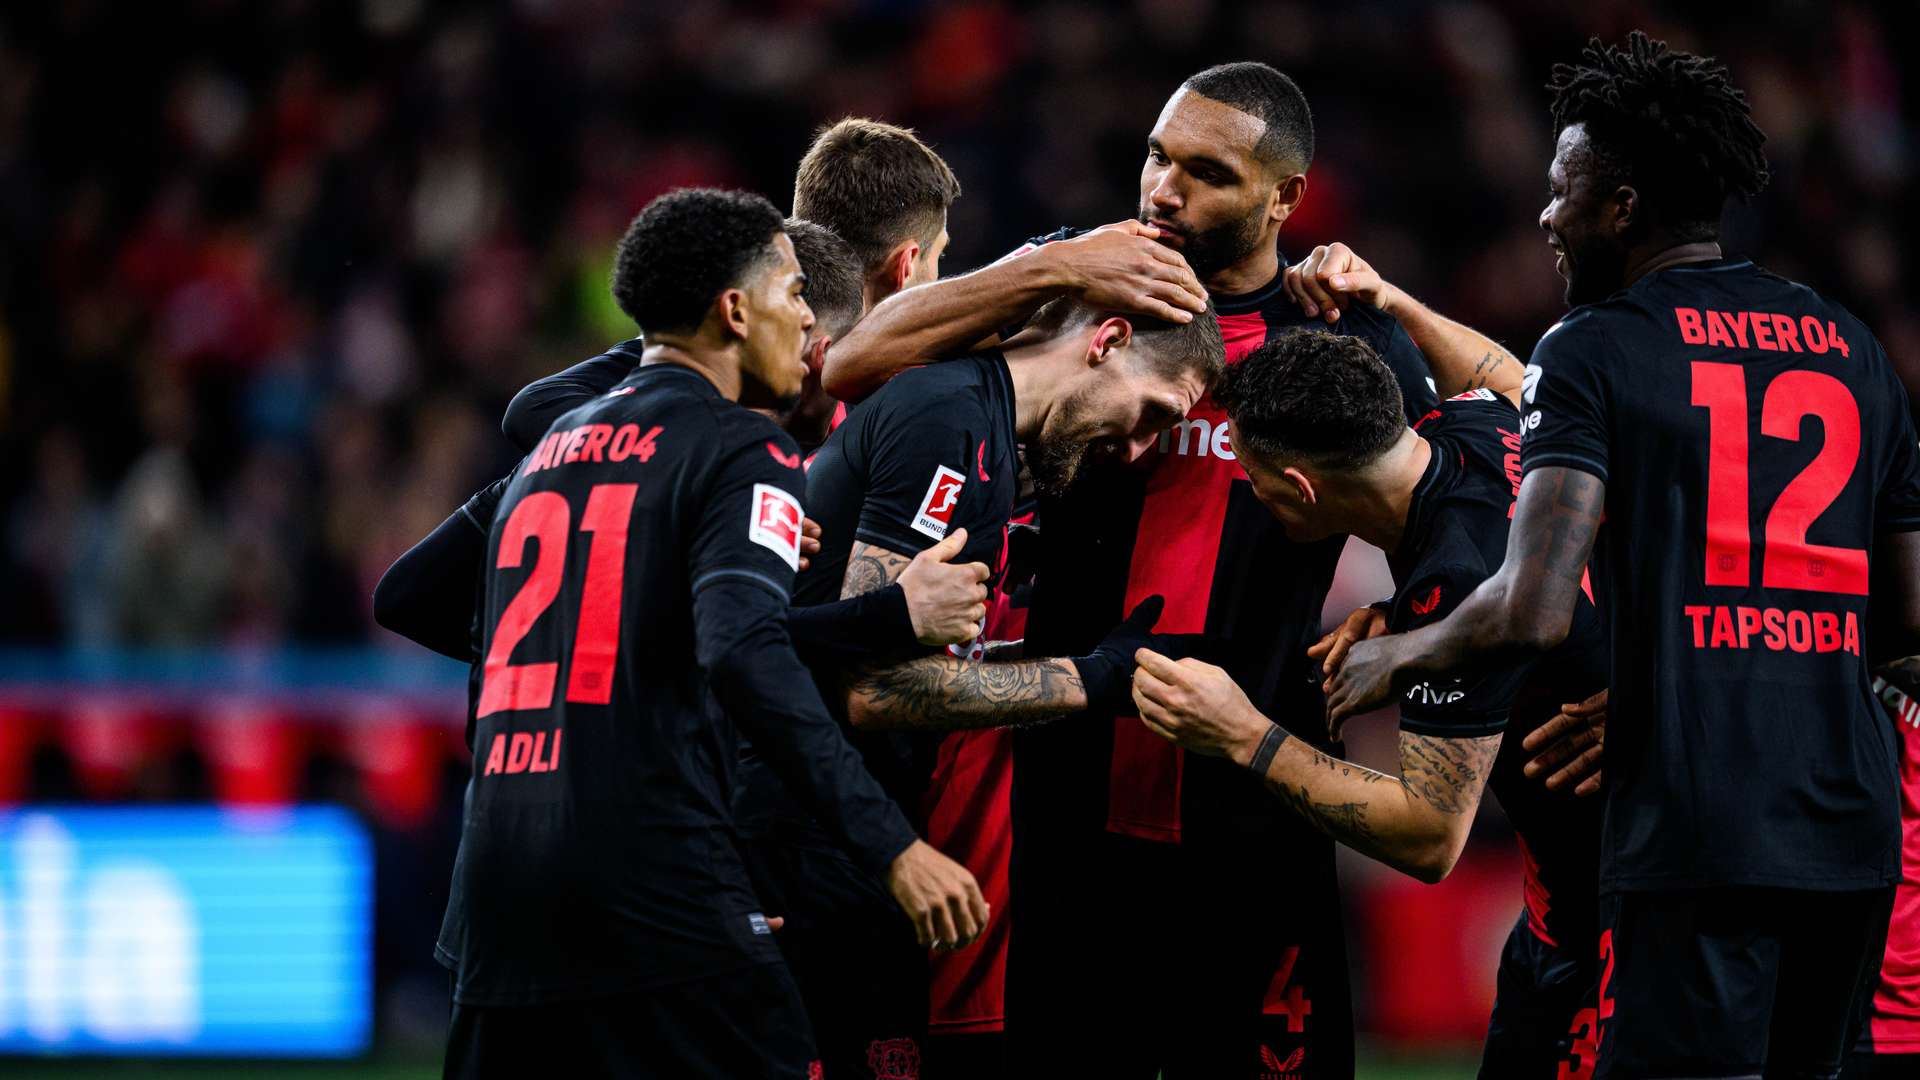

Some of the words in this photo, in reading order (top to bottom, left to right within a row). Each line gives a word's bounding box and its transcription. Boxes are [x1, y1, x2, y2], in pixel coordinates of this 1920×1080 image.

[1675, 307, 1850, 359] BAYER04
[1691, 361, 1869, 596] 12
[476, 483, 639, 719] 21
[1685, 605, 1860, 657] TAPSOBA
[1406, 681, 1465, 704] rive
[484, 729, 562, 776] ADLI
[1262, 946, 1312, 1032] 4
